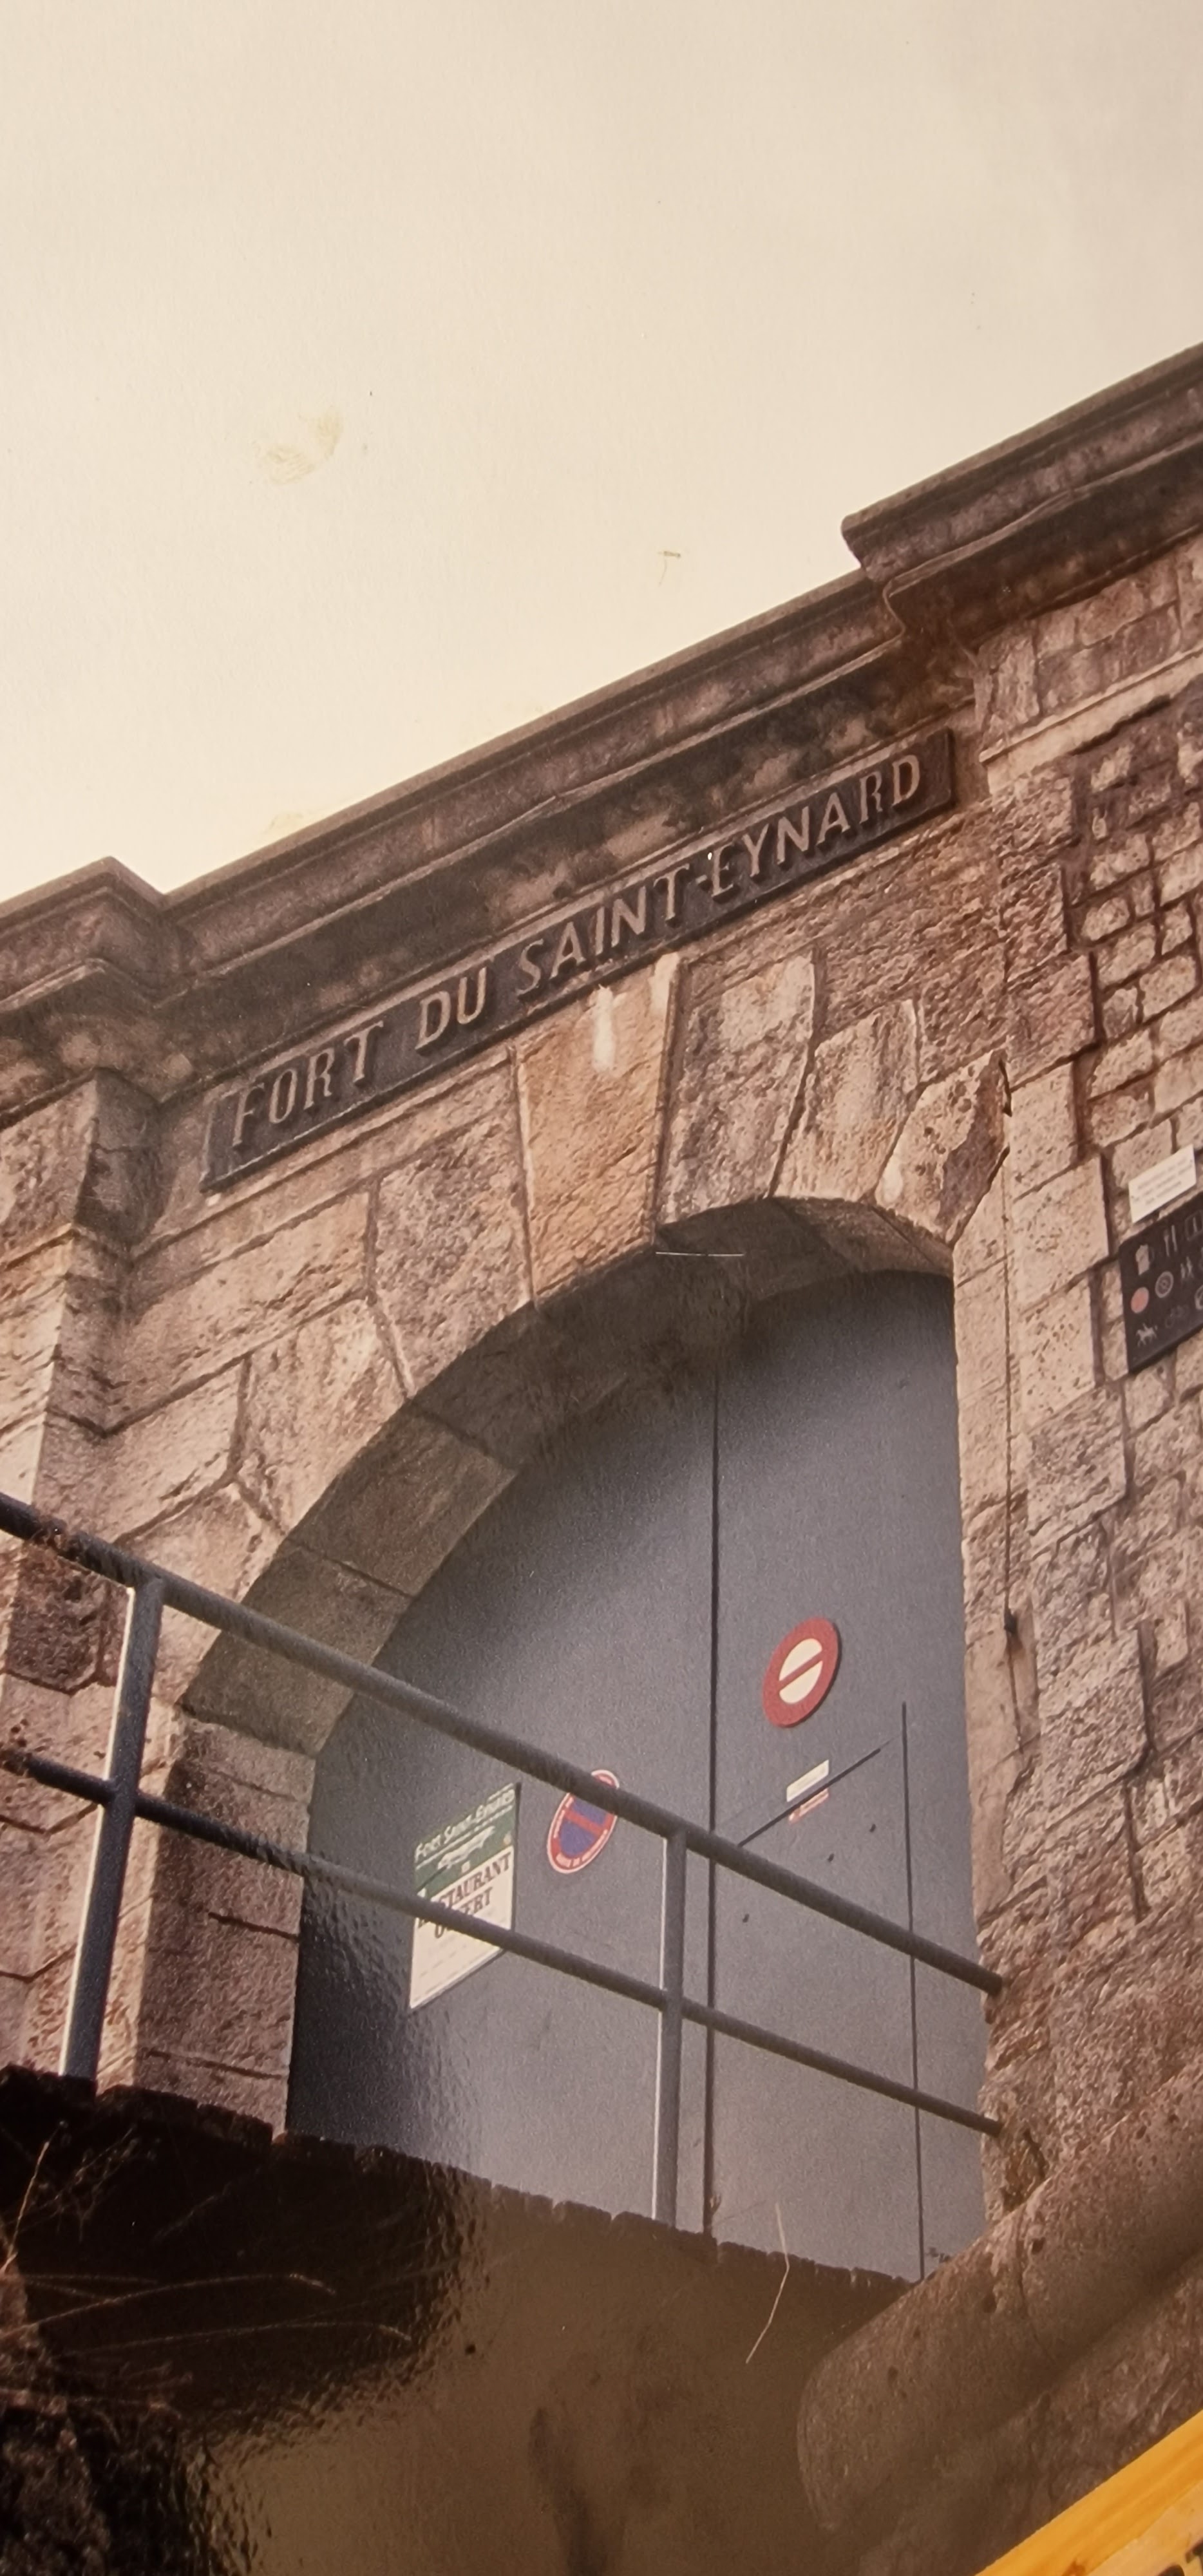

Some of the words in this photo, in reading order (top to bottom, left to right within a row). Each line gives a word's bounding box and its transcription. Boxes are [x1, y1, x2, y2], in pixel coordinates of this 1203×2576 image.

[232, 1020, 384, 1147] FORT
[415, 967, 488, 1050] DU
[517, 753, 921, 996] SAINT-EYNARD
